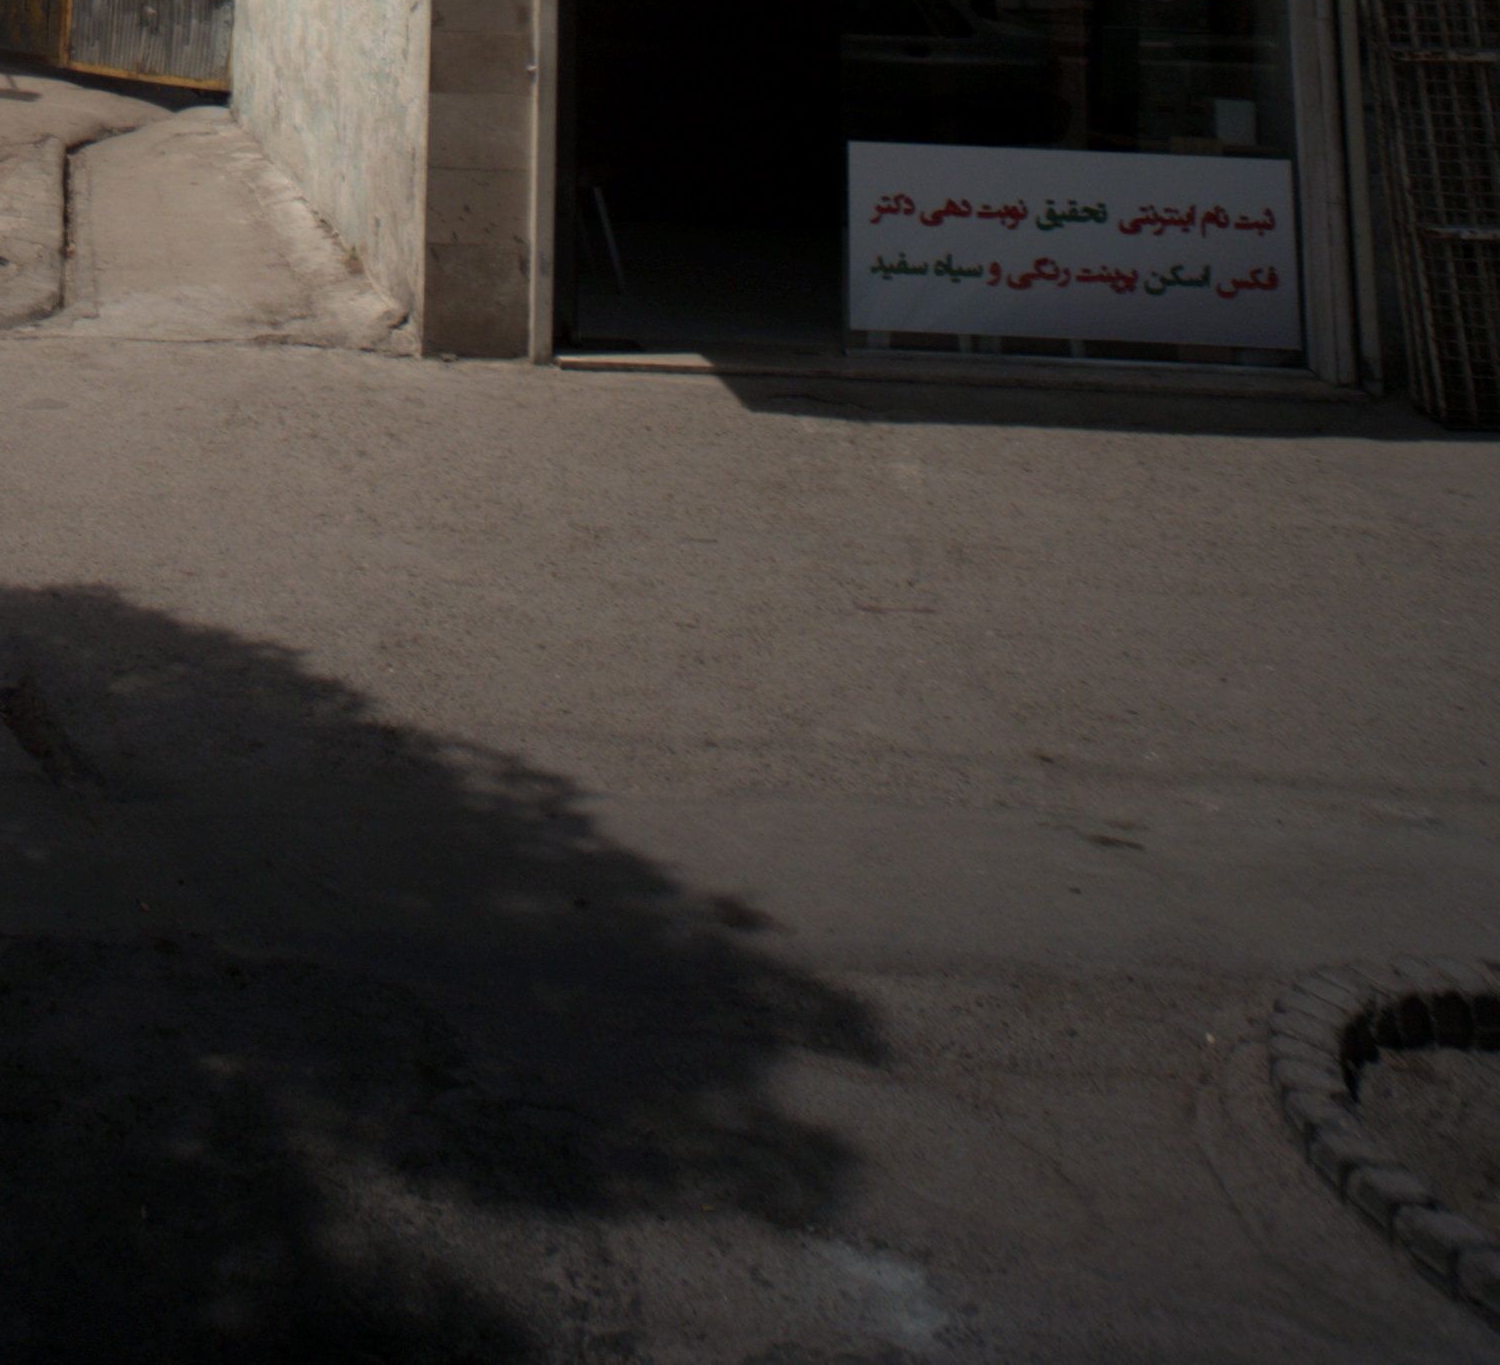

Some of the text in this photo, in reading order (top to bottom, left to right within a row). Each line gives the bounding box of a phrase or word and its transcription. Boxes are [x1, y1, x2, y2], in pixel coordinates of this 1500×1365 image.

[870, 193, 1277, 238] ثبت نام اینترنتی تحقیق نوبت دهی دکتر
[870, 252, 1280, 299] فکس اسکن پرینت رنگی و سیاه سفید
